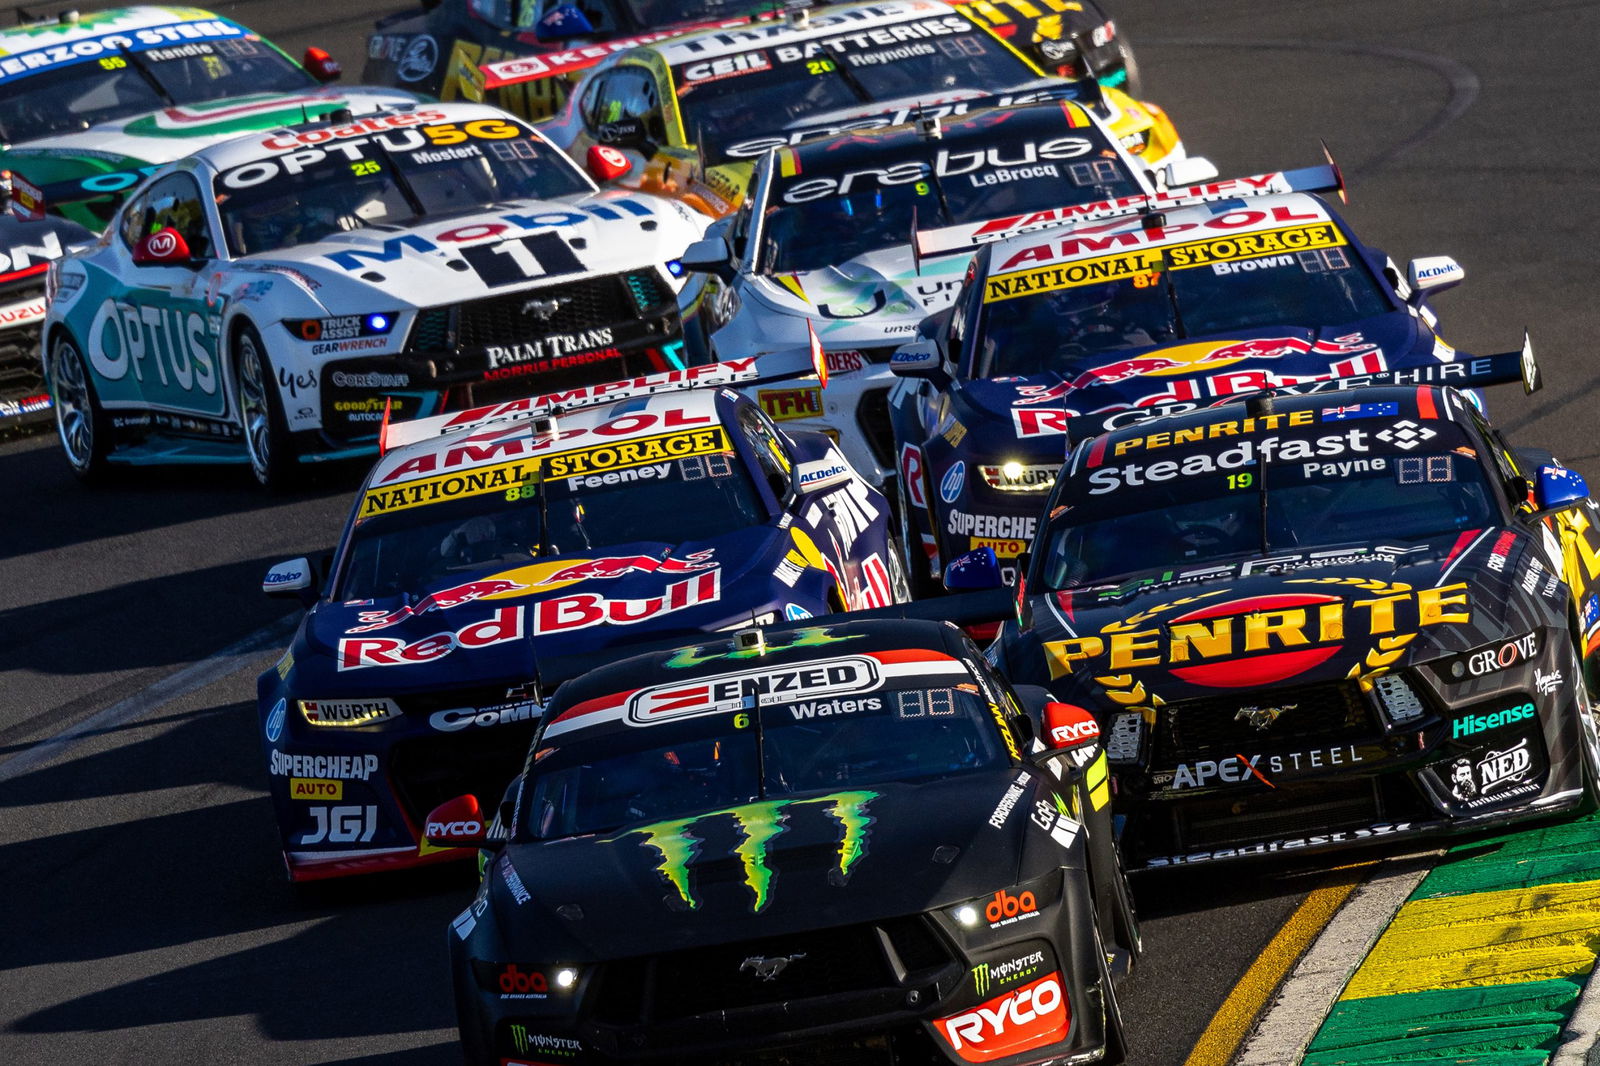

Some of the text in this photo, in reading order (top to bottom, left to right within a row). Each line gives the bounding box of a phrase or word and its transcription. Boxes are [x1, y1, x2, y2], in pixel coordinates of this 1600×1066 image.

[136, 20, 241, 45] STEEL
[775, 16, 972, 63] BATTERIES
[99, 56, 127, 71] 55
[848, 41, 936, 67] Reynolds
[351, 160, 381, 177] 25
[412, 143, 483, 165] Mostert
[783, 137, 1093, 203] erebus
[969, 163, 1059, 188] LeBrocq
[915, 181, 930, 196] 9
[1019, 172, 1276, 227] AMPLIFY
[1000, 205, 1319, 271] AMPOL
[988, 224, 1329, 298] NATIONAL STORAGE
[1212, 253, 1294, 276] Brown
[1133, 271, 1161, 289] 87
[0, 303, 46, 324] UZU
[321, 316, 361, 329] TRUCK
[88, 298, 217, 395] OPTUS
[312, 338, 388, 355] GEARWRENCH
[321, 328, 361, 340] ASSIST
[487, 328, 614, 369] PALM TRANS
[483, 348, 623, 381] MORRIS PERSONAL
[1394, 358, 1493, 385] HIRE
[279, 366, 317, 398] yes
[490, 357, 757, 418] AMPLIFY
[1114, 410, 1314, 457] PENRITE
[366, 431, 716, 514] NATIONAL STORAGE
[567, 461, 671, 492] Feeney
[1088, 427, 1369, 496] Steadfast
[1303, 455, 1387, 479] Payne
[505, 485, 536, 502] 88
[1226, 472, 1253, 491] 19
[948, 508, 1037, 540] SUPERCHE
[977, 540, 1021, 554] AUTO
[337, 605, 524, 672] Red
[534, 567, 721, 636] Bull
[1042, 582, 1470, 681] PENRITE
[1468, 631, 1538, 676] GROVE
[713, 664, 858, 702] ENZED
[733, 713, 750, 729] 6
[789, 697, 882, 720] Waters
[1452, 702, 1535, 740] Hisense
[1051, 720, 1100, 741] RYCO
[270, 748, 379, 781] SUPERCHEAP
[1172, 754, 1276, 790] APEX
[1270, 744, 1363, 773] STEEL
[1481, 748, 1530, 786] NED
[295, 782, 337, 796] AUTO
[300, 804, 378, 845] JGI
[426, 820, 481, 836] RYCO
[985, 889, 1037, 923] dba
[499, 963, 549, 993] dba
[1000, 966, 1038, 985] ENERGY
[945, 979, 1062, 1050] RYCO
